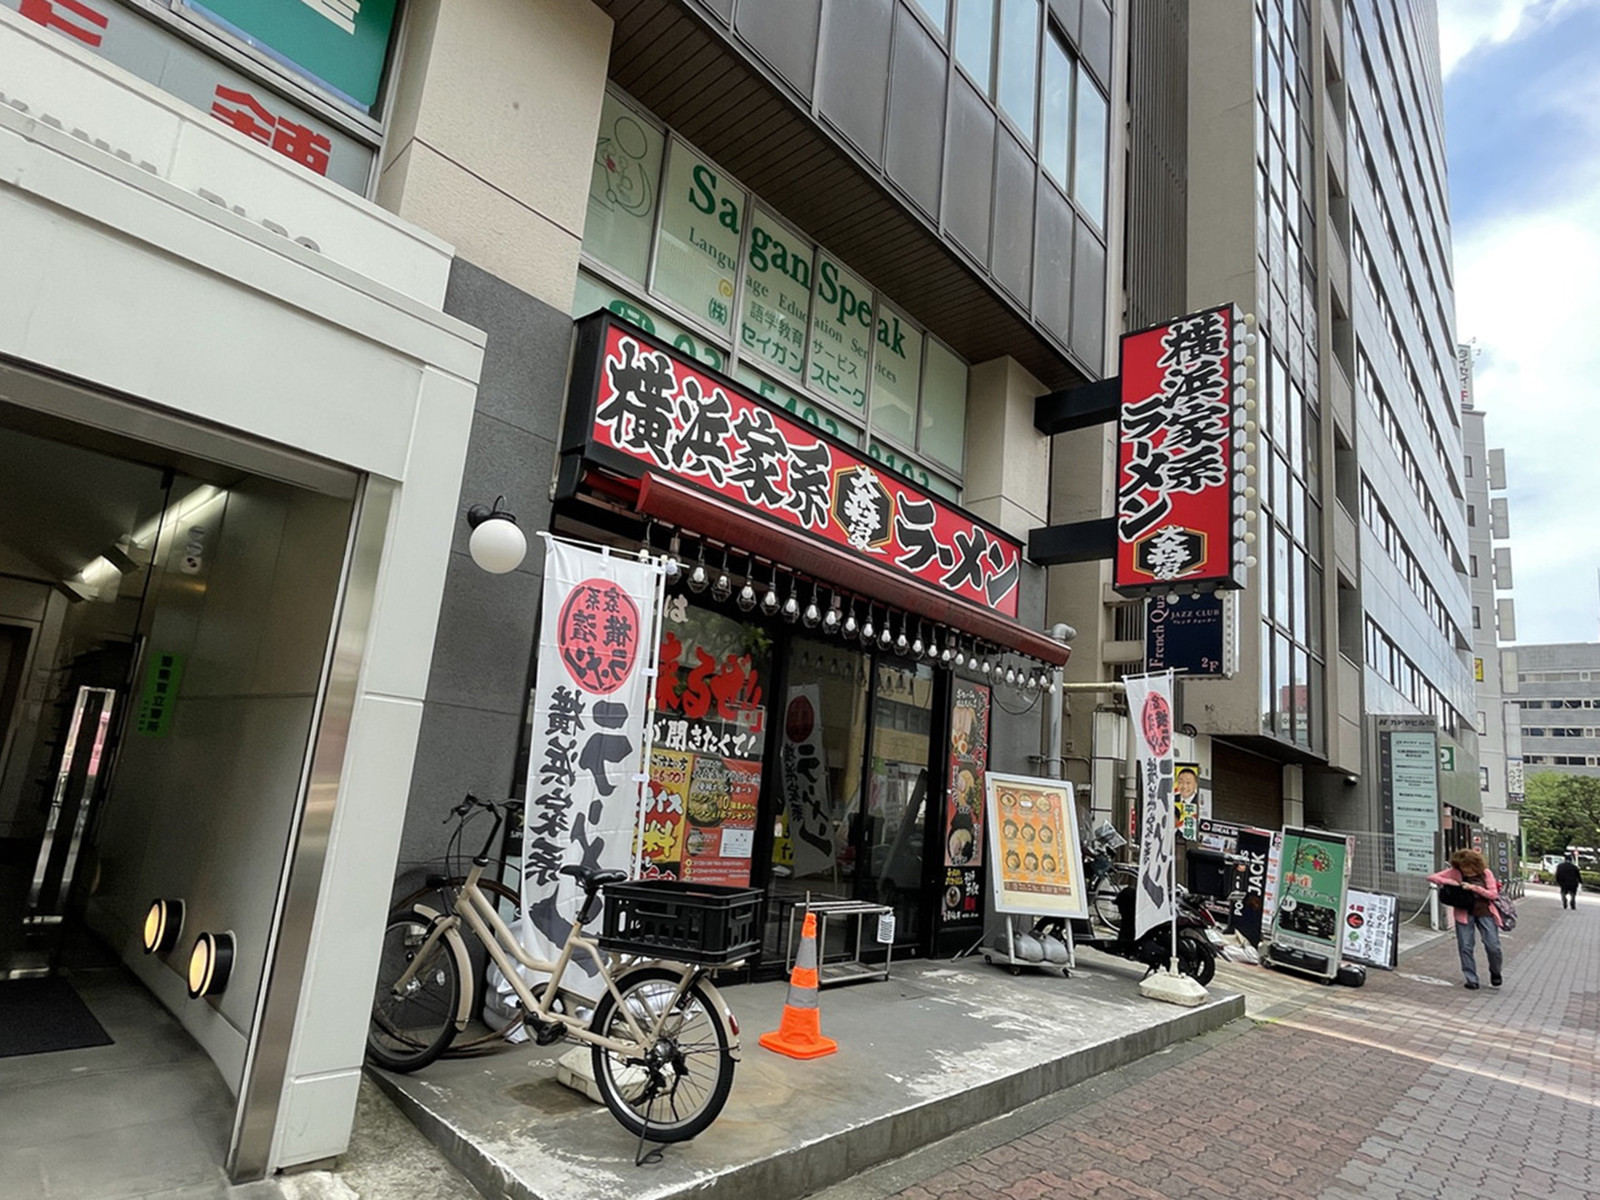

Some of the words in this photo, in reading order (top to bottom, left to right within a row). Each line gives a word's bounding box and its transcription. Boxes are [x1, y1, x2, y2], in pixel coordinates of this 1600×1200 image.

[688, 226, 770, 298] Language
[778, 292, 843, 344] Education
[851, 337, 897, 384] Serices
[818, 260, 906, 359] Speak
[596, 336, 832, 530] 横浜家系
[1157, 312, 1230, 494] 横浜家系
[1117, 396, 1173, 544] ラーメン
[894, 490, 1019, 608] ラーメン
[1149, 625, 1165, 668] French
[1171, 609, 1193, 620] JAZZ
[1195, 607, 1220, 617] CLUB
[1201, 657, 1219, 672] 2F
[1247, 851, 1266, 896] JACK
